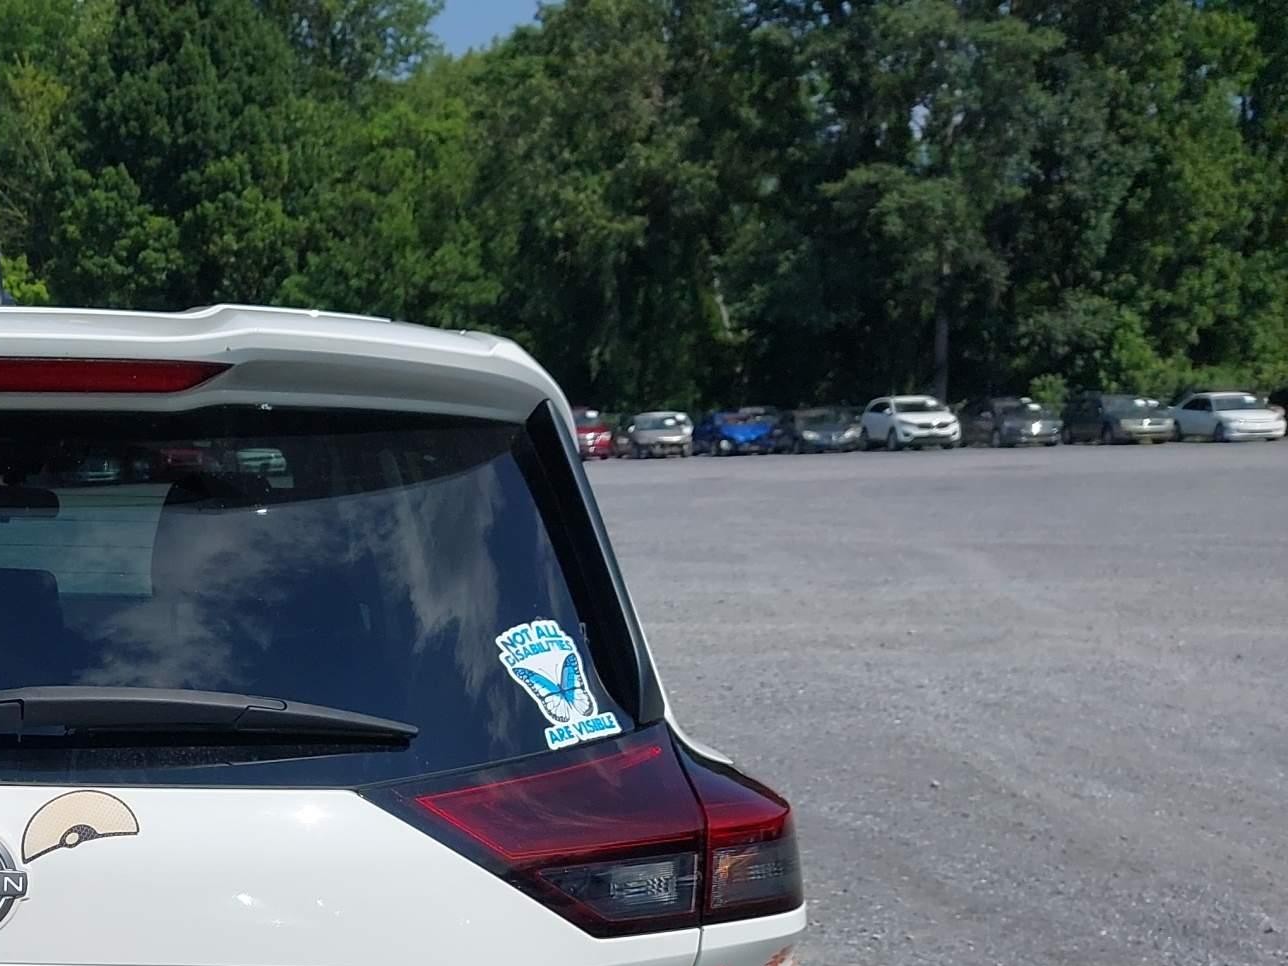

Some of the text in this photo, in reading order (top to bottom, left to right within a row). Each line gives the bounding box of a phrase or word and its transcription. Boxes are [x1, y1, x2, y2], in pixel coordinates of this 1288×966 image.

[501, 624, 562, 651] NOT ALL
[504, 640, 573, 667] DISABILITIES
[548, 716, 616, 744] ARE VISIBLE
